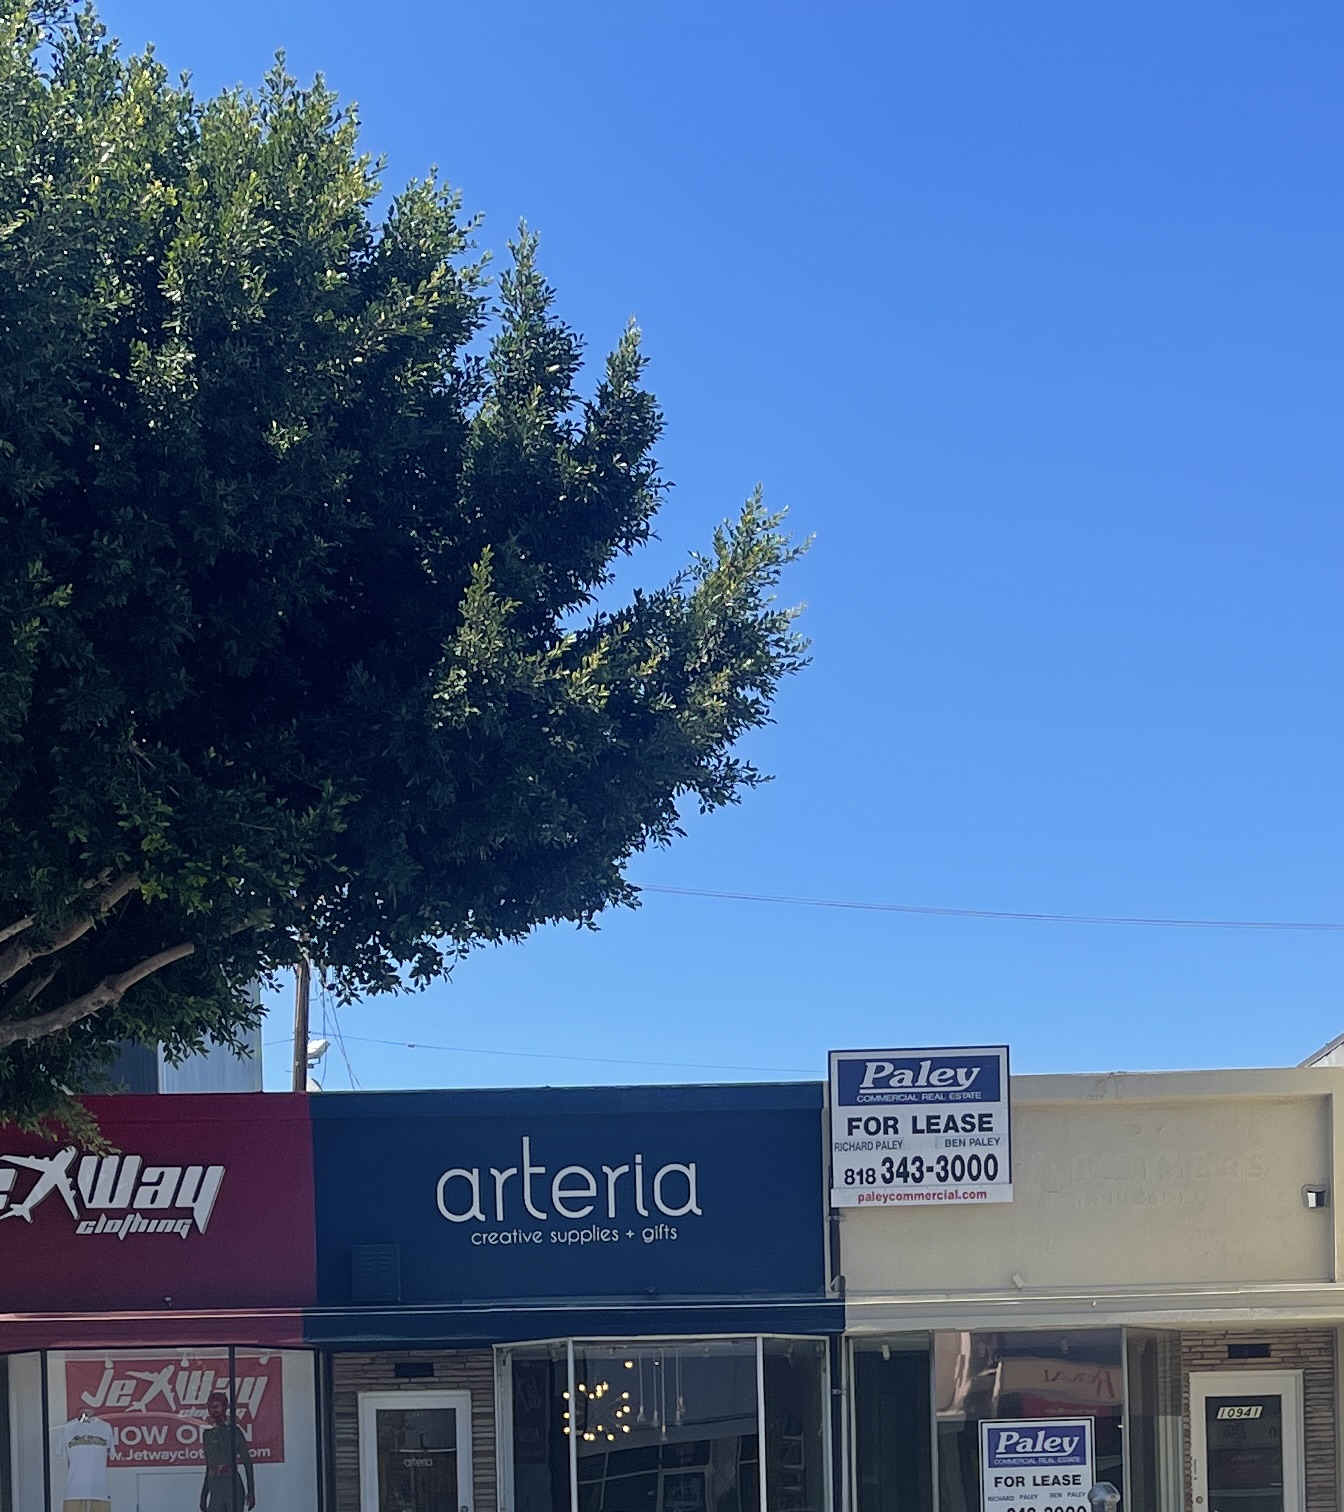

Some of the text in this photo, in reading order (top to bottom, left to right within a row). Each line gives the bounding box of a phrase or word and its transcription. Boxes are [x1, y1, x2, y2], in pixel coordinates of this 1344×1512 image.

[859, 1060, 981, 1091] Paley
[857, 1091, 982, 1103] COMMERCIAL REAL ESTATE
[847, 1113, 993, 1136] FOR LEASE
[834, 1139, 903, 1152] RICHARD PALEY
[944, 1137, 1001, 1148] BEN PALEY
[844, 1153, 999, 1185] 818 343-3000
[436, 1135, 703, 1223] arteria
[858, 1189, 987, 1204] paleycommercial.com
[76, 1212, 193, 1241] clothing
[471, 1223, 678, 1246] creative supplies + gifts
[1220, 1407, 1259, 1418] 10941
[995, 1430, 1080, 1458] Paley
[993, 1457, 1037, 1465] COMMERCIAL
[994, 1474, 1082, 1488] FOR LEASE
